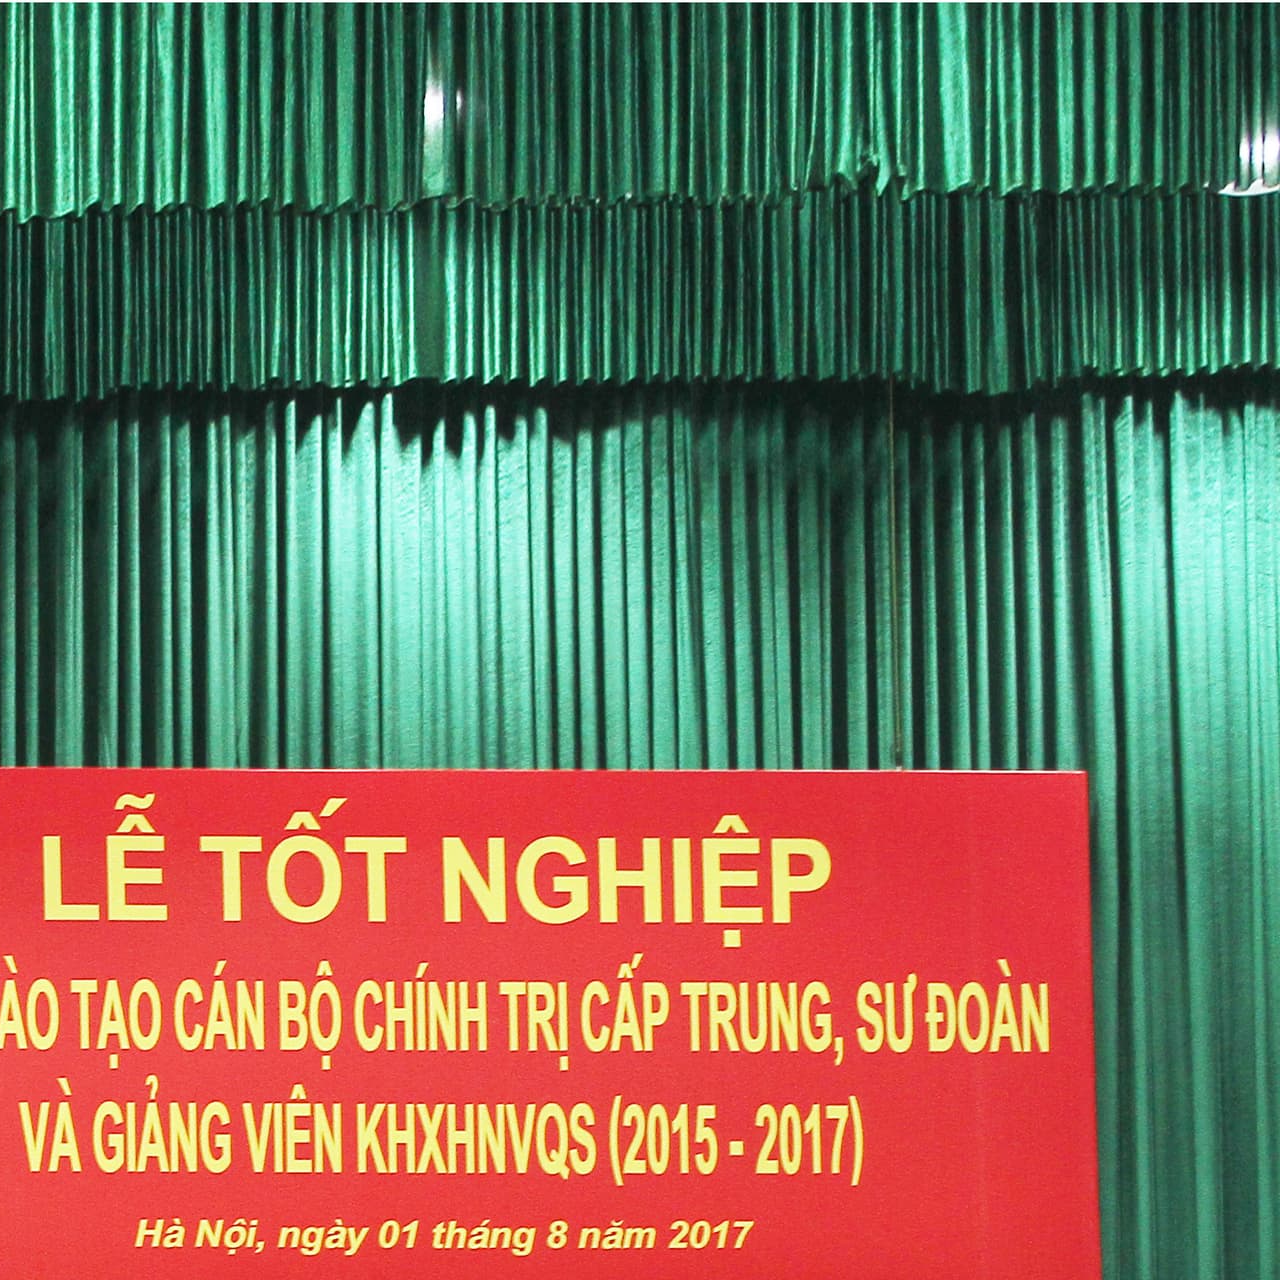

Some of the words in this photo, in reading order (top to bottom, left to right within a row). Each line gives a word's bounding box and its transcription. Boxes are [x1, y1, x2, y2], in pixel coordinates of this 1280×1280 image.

[43, 794, 168, 920] LỄ
[200, 798, 407, 923] TỐT
[442, 815, 831, 947] NGHIỆP
[70, 979, 162, 1069] TẠO
[174, 960, 265, 1050] CÁN
[279, 961, 342, 1070] BỘ
[354, 963, 487, 1051] CHÍNH
[499, 982, 569, 1070] TRỊ
[581, 953, 669, 1052] CẤP
[680, 982, 844, 1066] TRUNG,
[856, 973, 917, 1052] SƯ
[925, 959, 1049, 1052] ĐOÀN
[19, 1078, 82, 1171] VÀ
[93, 1074, 231, 1173] GIẢNG
[242, 1084, 342, 1173] VIÊN
[356, 1103, 597, 1179] KHXHNVQS
[609, 1096, 718, 1186] (2015
[755, 1096, 863, 1186] 2017)
[135, 1218, 185, 1248] Hà
[195, 1219, 264, 1256] Nội,
[278, 1219, 369, 1256] ngày
[378, 1220, 418, 1248] 01
[432, 1220, 536, 1257] tháng
[547, 1221, 568, 1248] 8
[578, 1221, 656, 1249] năm
[668, 1221, 754, 1249] 2017
